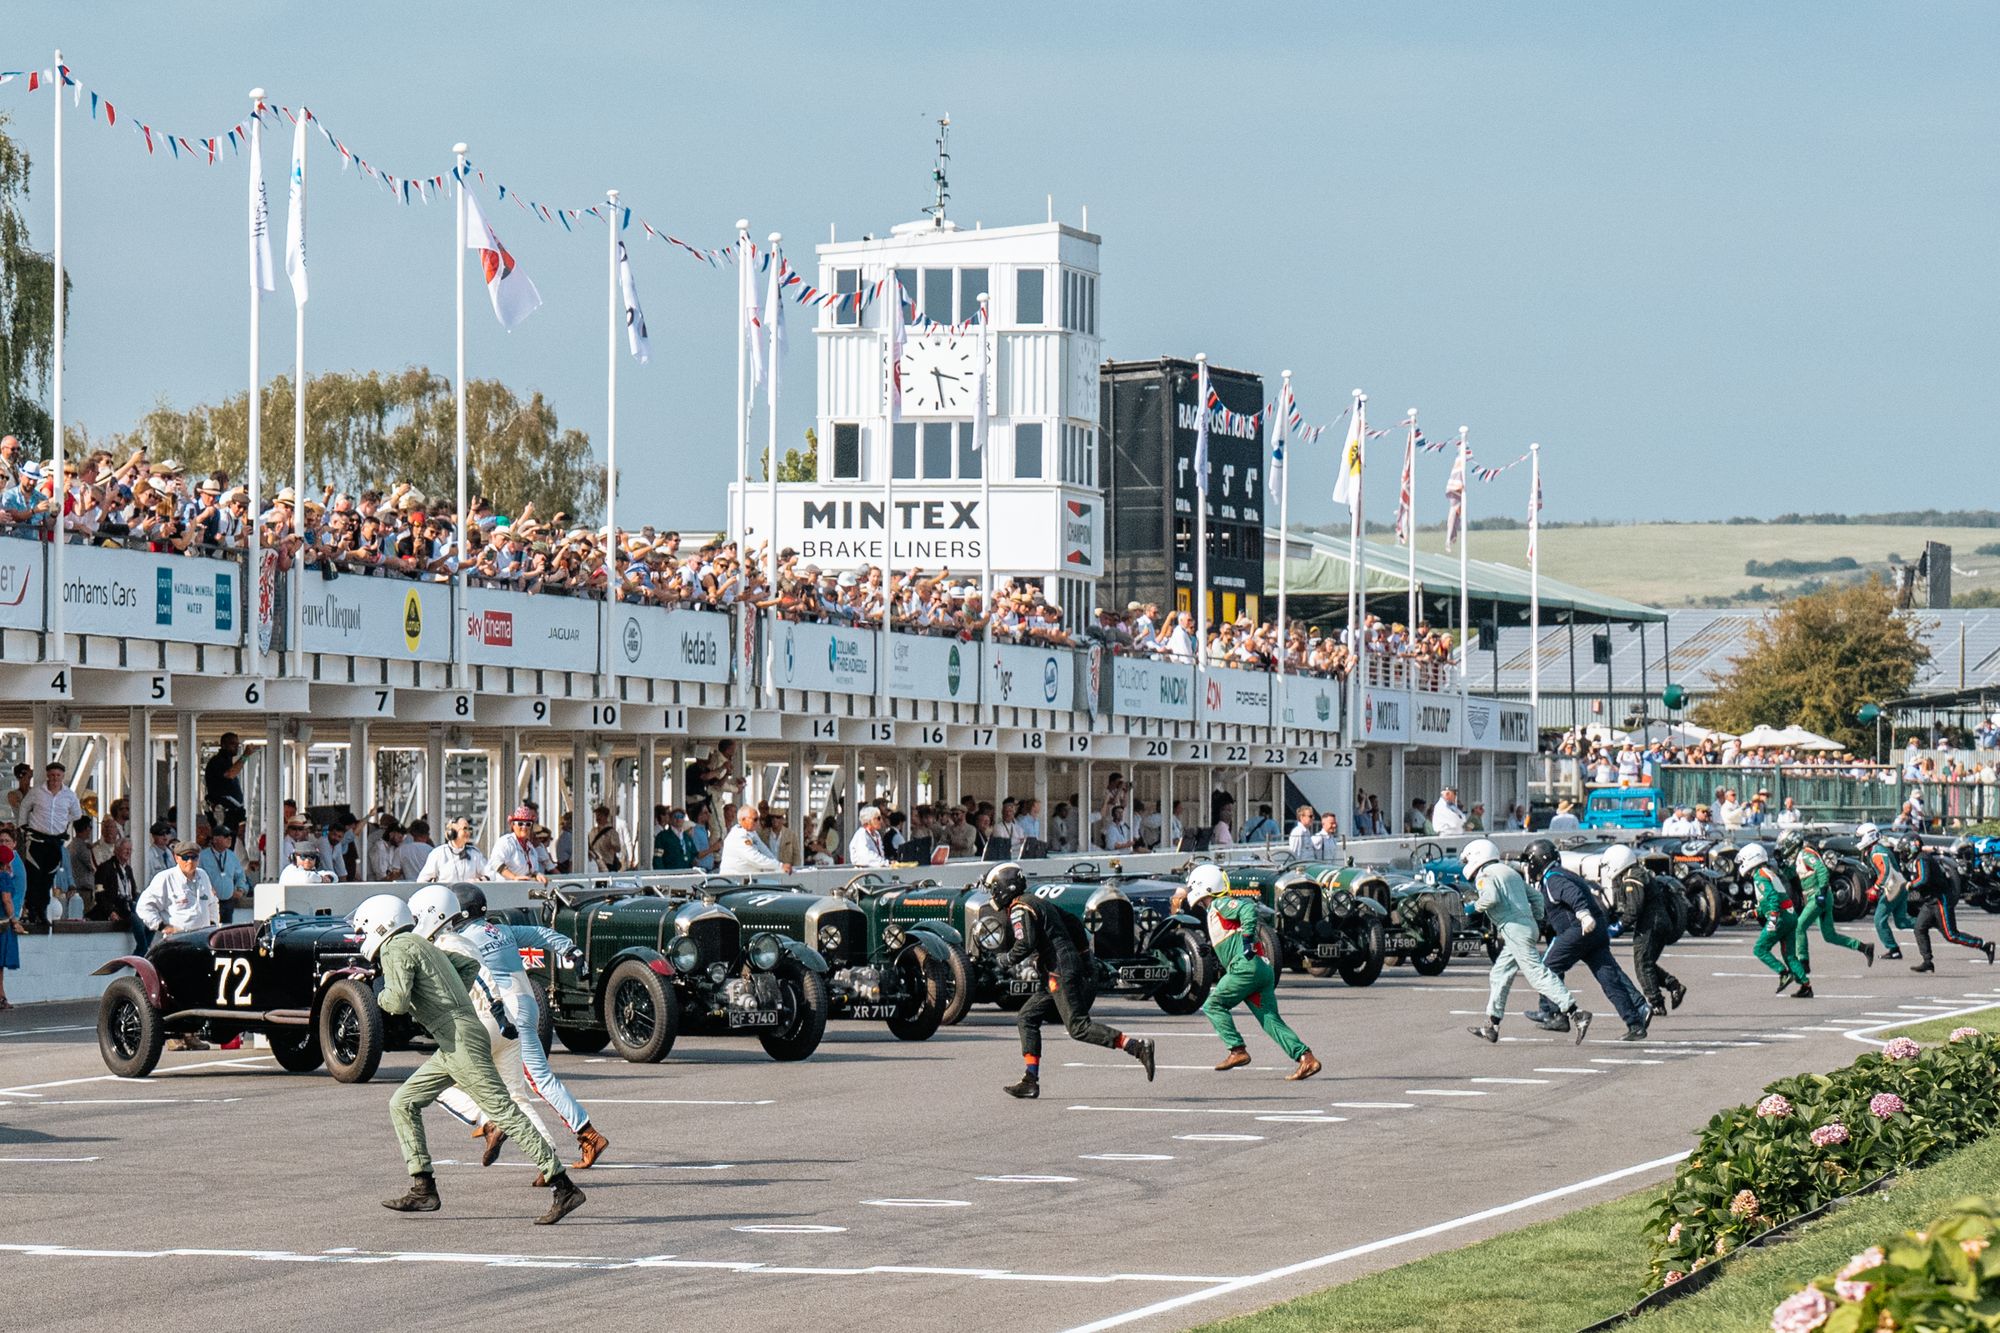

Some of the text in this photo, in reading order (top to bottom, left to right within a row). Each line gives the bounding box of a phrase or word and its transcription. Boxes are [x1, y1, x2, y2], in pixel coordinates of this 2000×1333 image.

[1179, 403, 1199, 430] RAC
[803, 501, 980, 529] MINTEX
[803, 541, 981, 558] BRAKE LINERS
[63, 576, 137, 607] onhams Cars
[187, 602, 202, 614] WATER
[302, 593, 361, 637] euve Clicquot
[467, 612, 512, 642] sky cinema
[548, 627, 580, 641] JAGUAR
[51, 670, 67, 693] 4
[151, 677, 165, 699] 5
[245, 683, 260, 704] 6
[375, 691, 389, 711] 7
[1206, 677, 1221, 711] AON
[455, 696, 469, 715] 8
[533, 701, 546, 720] 9
[593, 705, 617, 725] 10
[664, 710, 683, 728] 11
[725, 714, 746, 732] 12
[1377, 701, 1400, 731] MOTUL
[1422, 706, 1450, 733] DUNLOP
[814, 720, 835, 737] 14
[871, 724, 891, 740] 15
[1500, 710, 1529, 742] MINTEX
[923, 727, 943, 743] 16
[973, 729, 993, 746] 17
[1022, 732, 1042, 749] 18
[1069, 736, 1089, 751] 19
[1147, 741, 1168, 756] 20
[1190, 745, 1208, 759] 21
[1226, 746, 1247, 761] 22
[1265, 749, 1284, 763] 23
[1299, 751, 1318, 765] 24
[1334, 753, 1353, 767] 25
[213, 957, 253, 1006] 72
[1122, 968, 1168, 979] RK 8140
[1014, 982, 1028, 993] GP
[732, 1012, 776, 1024] KF 3740
[853, 1005, 896, 1018] XR 7117
